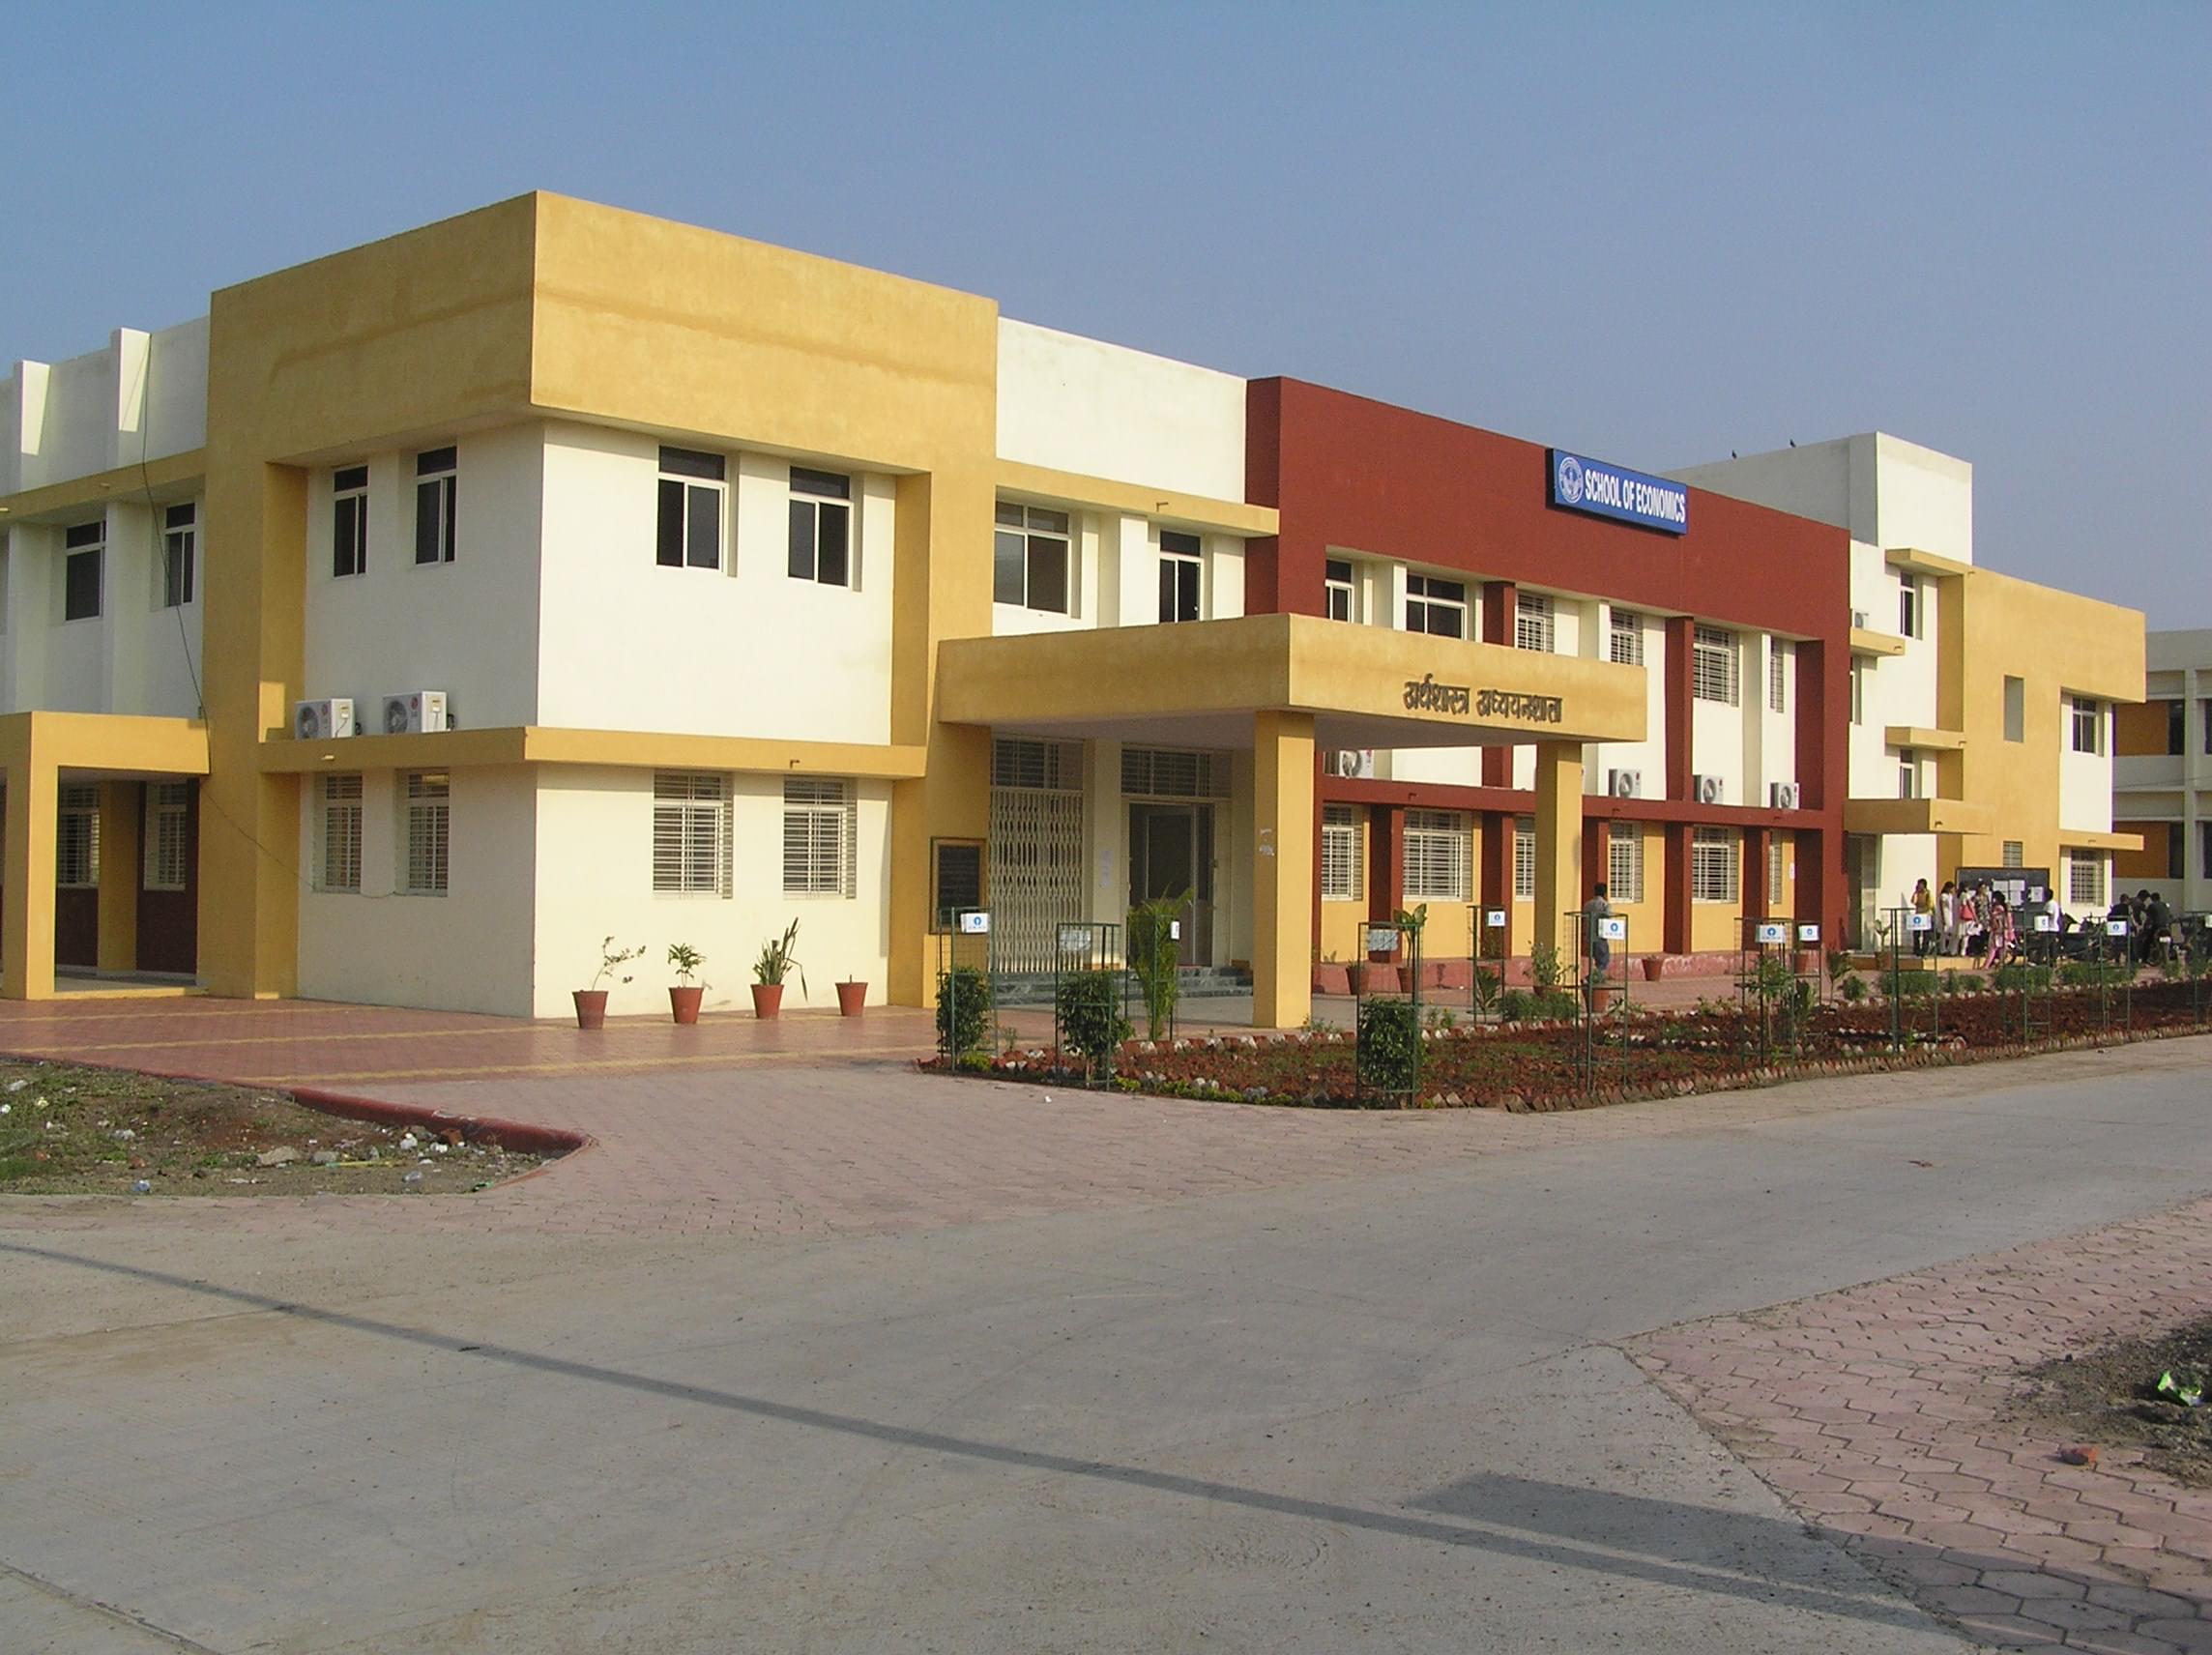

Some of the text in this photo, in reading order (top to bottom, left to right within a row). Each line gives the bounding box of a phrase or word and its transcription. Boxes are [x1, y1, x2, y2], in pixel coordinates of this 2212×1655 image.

[1585, 469, 1621, 508] SCHOOL
[1622, 479, 1635, 510] OF
[1636, 484, 1685, 523] ECONOMICS
[1403, 673, 1562, 723] अर्थशास्त्र अध्ययनशाला
